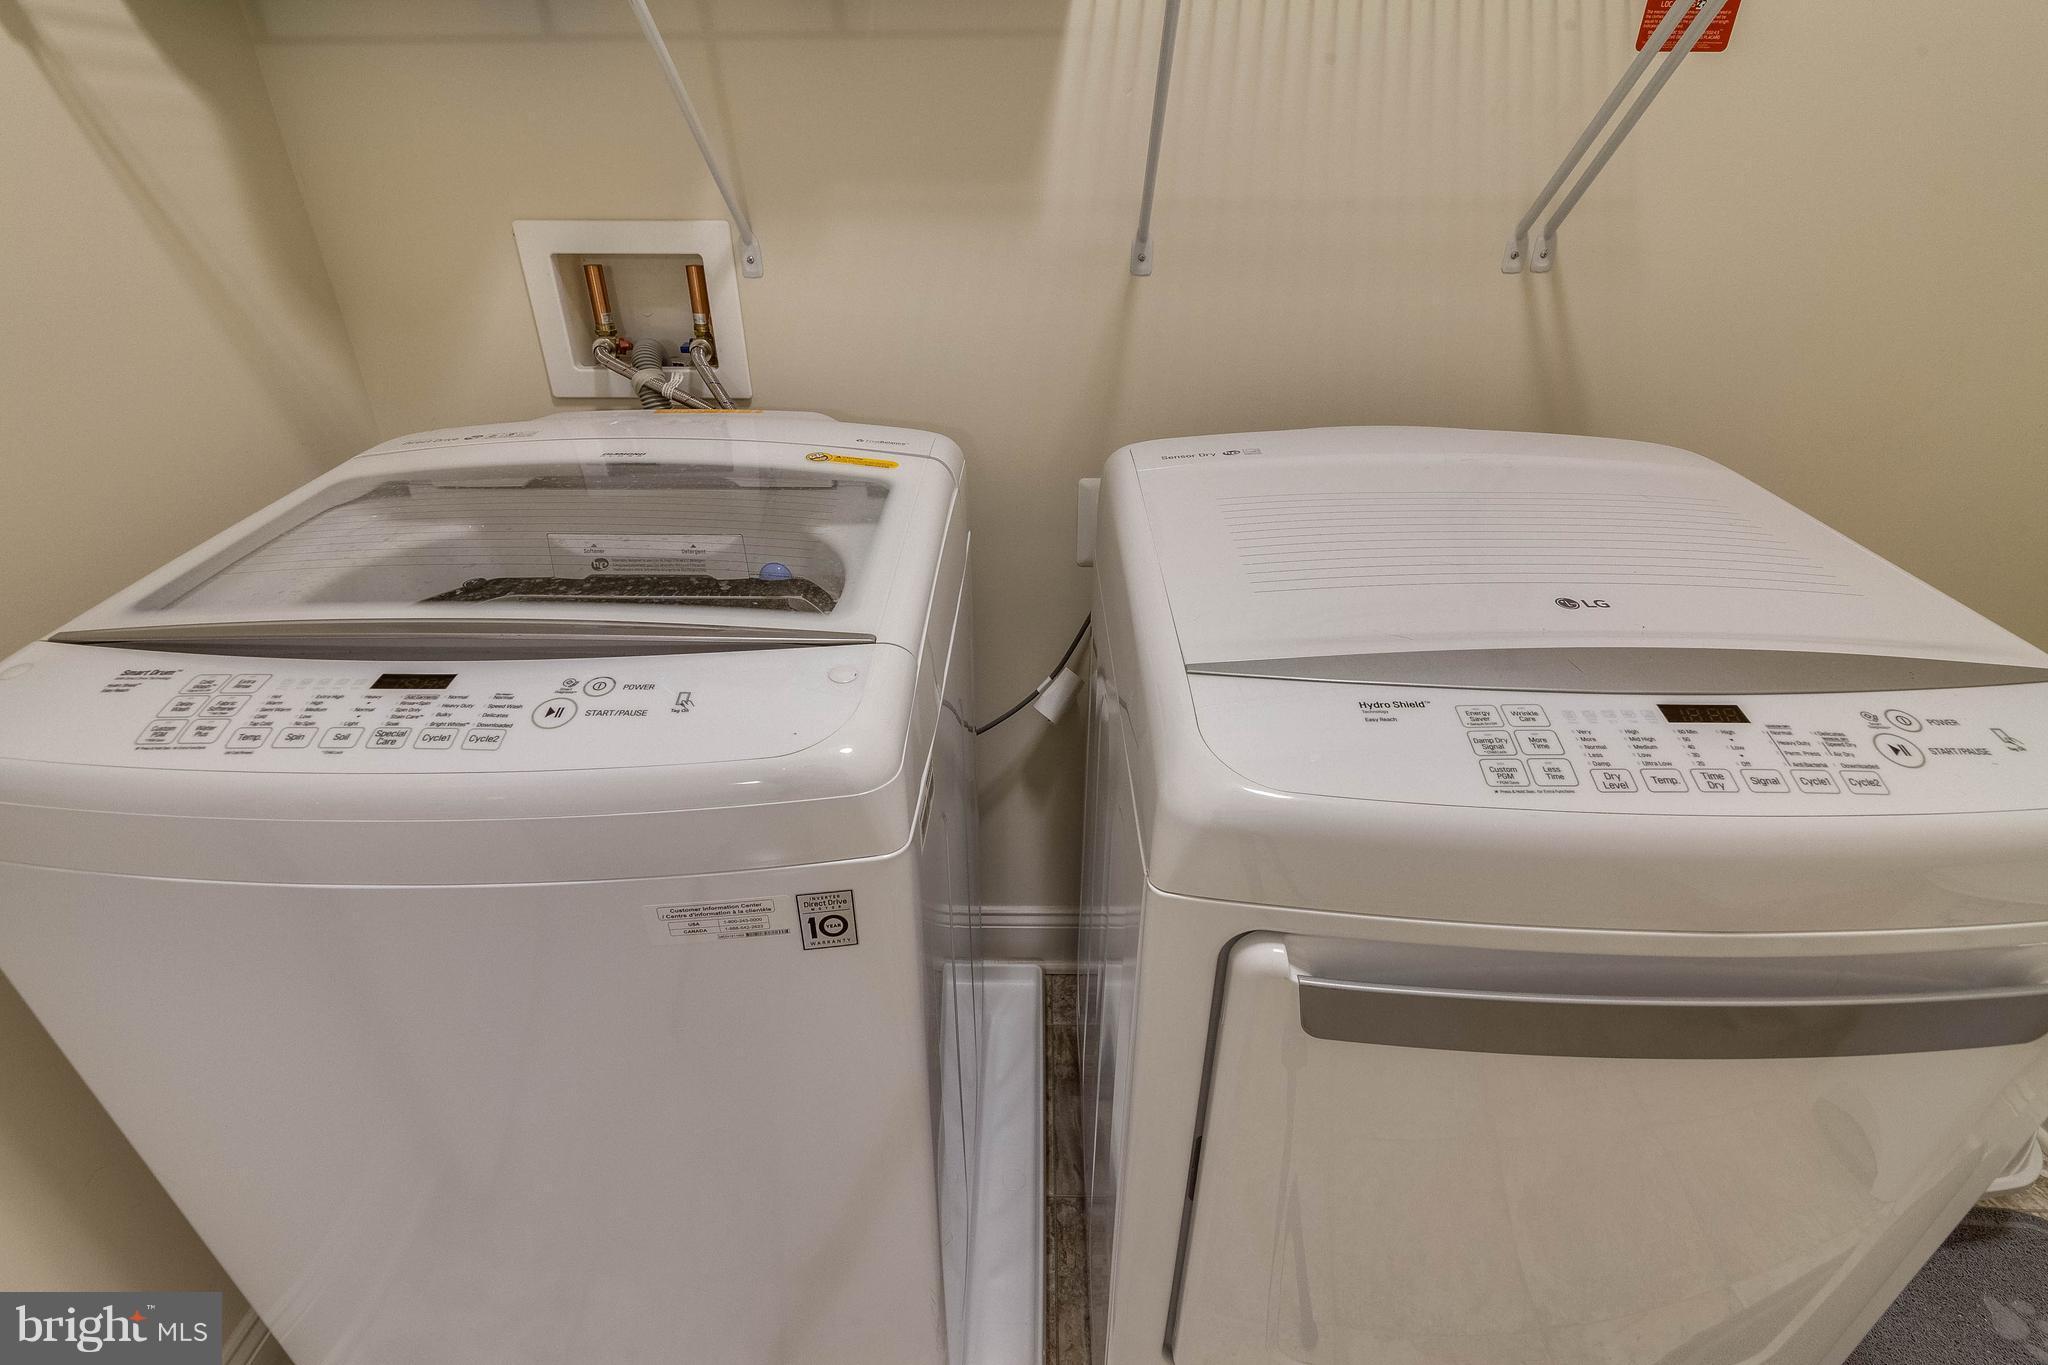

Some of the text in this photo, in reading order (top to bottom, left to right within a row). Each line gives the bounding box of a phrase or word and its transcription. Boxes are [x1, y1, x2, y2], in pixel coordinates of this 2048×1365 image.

[285, 733, 305, 742] Spin
[375, 730, 407, 738] Special
[422, 734, 451, 742] Cycle1
[469, 735, 500, 743] Cycle2
[1928, 748, 1992, 756] START/PAUSE
[1603, 772, 1621, 782] Dry
[1651, 776, 1681, 786] Temp.
[1750, 777, 1780, 786] Signal
[1800, 777, 1830, 786] Cycle1
[1707, 781, 1725, 790] Dry
[1849, 778, 1882, 787] Cycle2
[808, 915, 848, 939] 10
